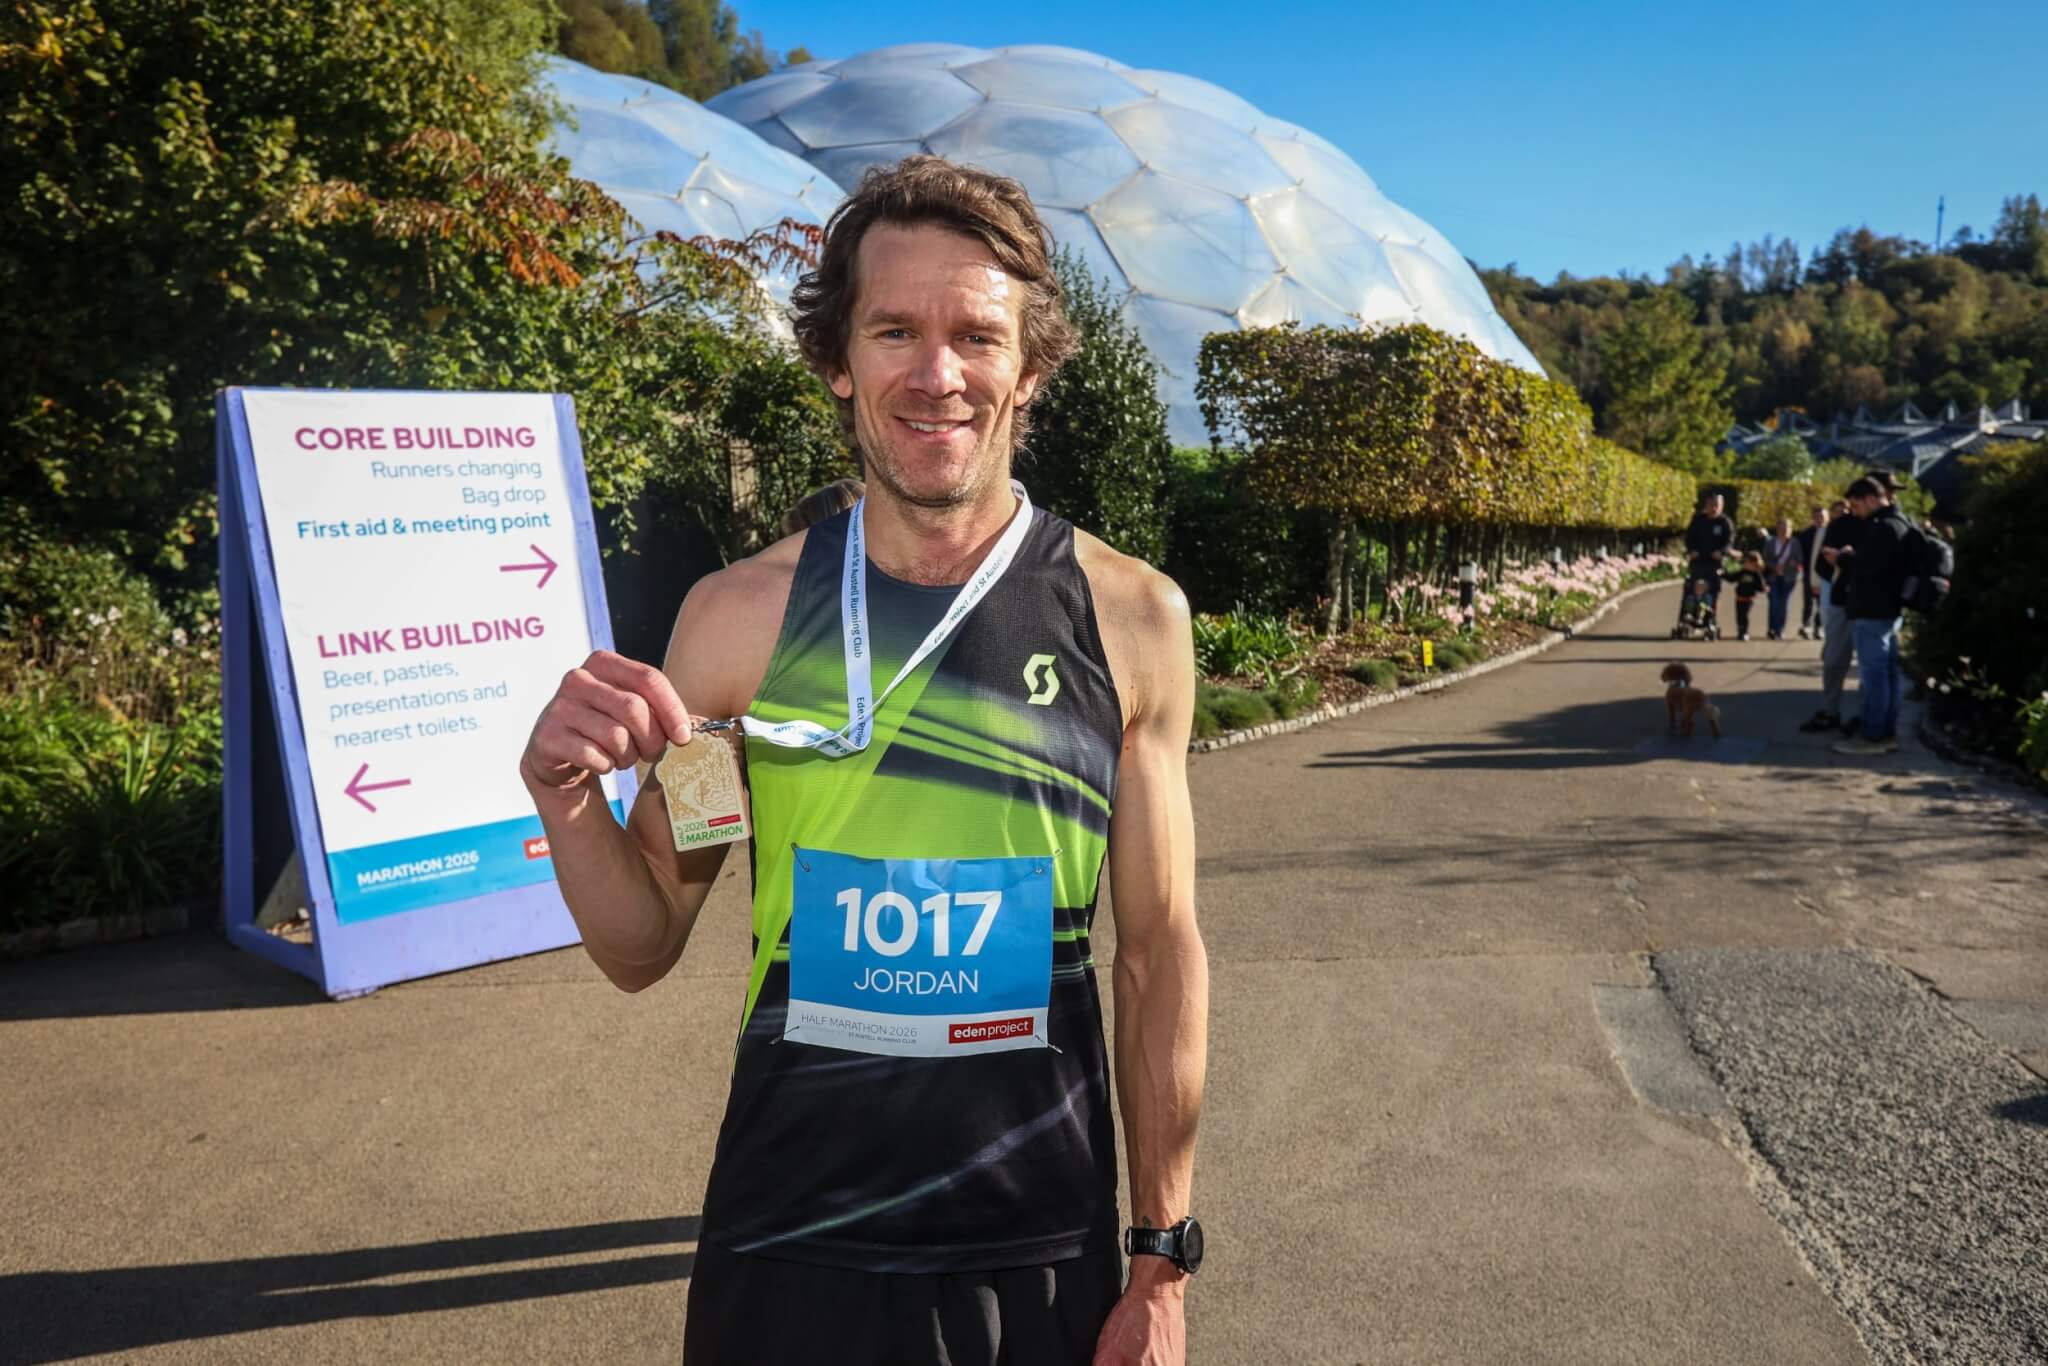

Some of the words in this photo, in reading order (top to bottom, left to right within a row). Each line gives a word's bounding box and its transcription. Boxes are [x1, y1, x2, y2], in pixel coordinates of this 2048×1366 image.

[294, 427, 388, 450] CORE
[393, 426, 536, 450] BUILDING
[371, 460, 455, 479] Runners
[457, 459, 542, 480] changing
[461, 486, 501, 507] Bag
[503, 486, 546, 505] drop
[297, 519, 351, 539] First
[355, 518, 388, 537] aid
[392, 517, 407, 536] &
[412, 514, 497, 535] meeting
[501, 511, 552, 533] point
[850, 597, 862, 636] Running
[317, 629, 396, 659] LINK
[401, 616, 545, 651] BUILDING
[852, 636, 863, 659] Club
[323, 668, 379, 689] Beer,
[383, 660, 459, 687] pasties,
[329, 686, 469, 722] presentations
[472, 680, 508, 701] and
[334, 723, 413, 749] nearest
[417, 715, 482, 738] toilets.
[683, 821, 707, 833] 2026
[686, 824, 744, 844] MARATHON
[357, 859, 444, 887] MARATHON
[444, 850, 480, 870] 2026
[836, 887, 1003, 957] 1017
[853, 967, 980, 996] JORDAN
[801, 1013, 829, 1026] HALF
[830, 1017, 888, 1035] MARATHON
[889, 1026, 918, 1038] 2026
[953, 1025, 987, 1039] eden
[987, 1021, 1029, 1038] project
